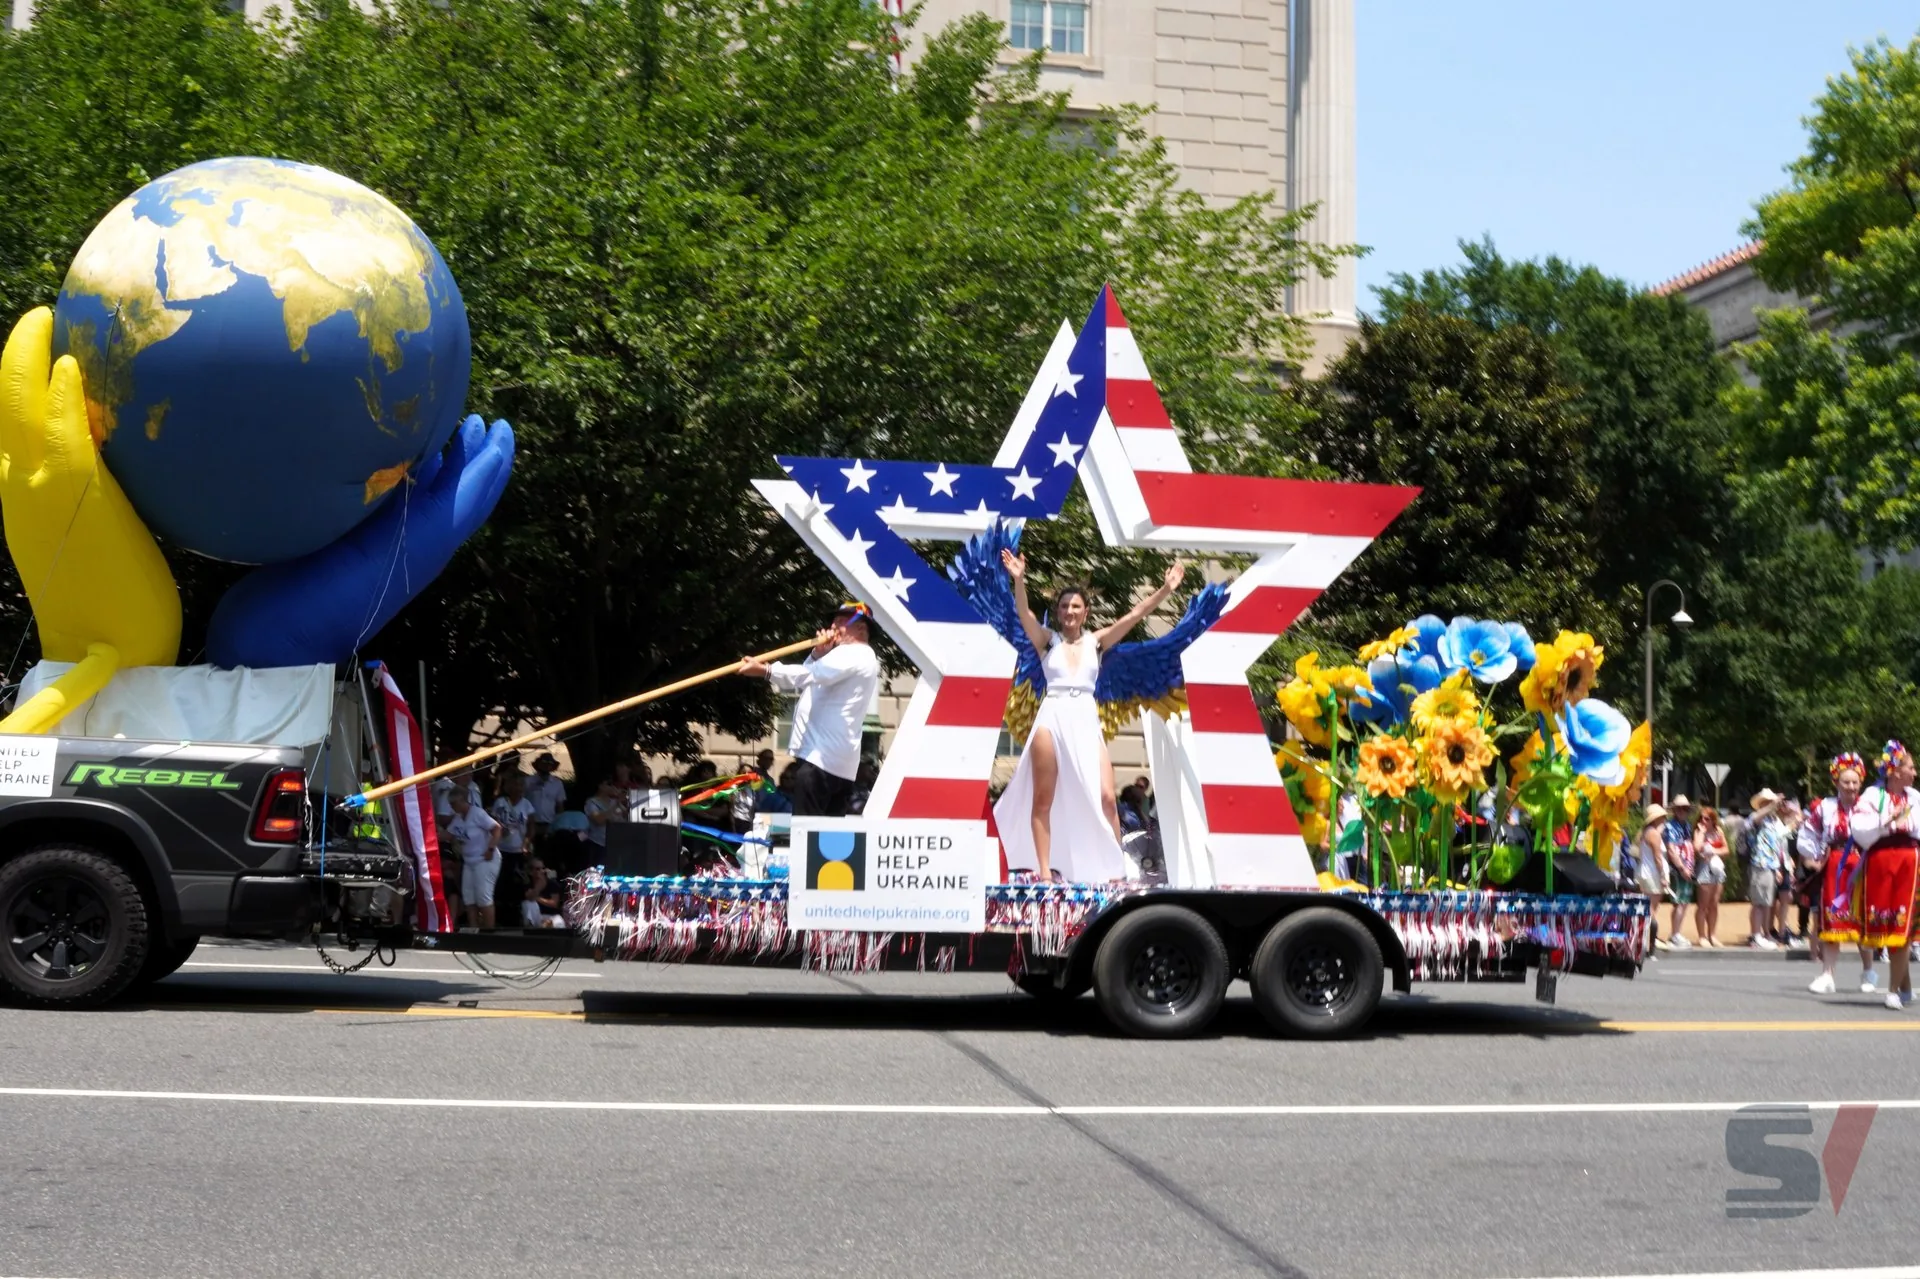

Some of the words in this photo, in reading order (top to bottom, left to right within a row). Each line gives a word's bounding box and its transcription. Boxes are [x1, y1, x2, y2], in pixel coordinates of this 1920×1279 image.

[0, 773, 50, 785] RAINE
[67, 762, 241, 790] REBEL
[878, 835, 953, 851] UNITED
[877, 855, 930, 870] HELP
[877, 874, 969, 890] UKRAINE
[804, 905, 970, 923] unitedhelpukraine.org
